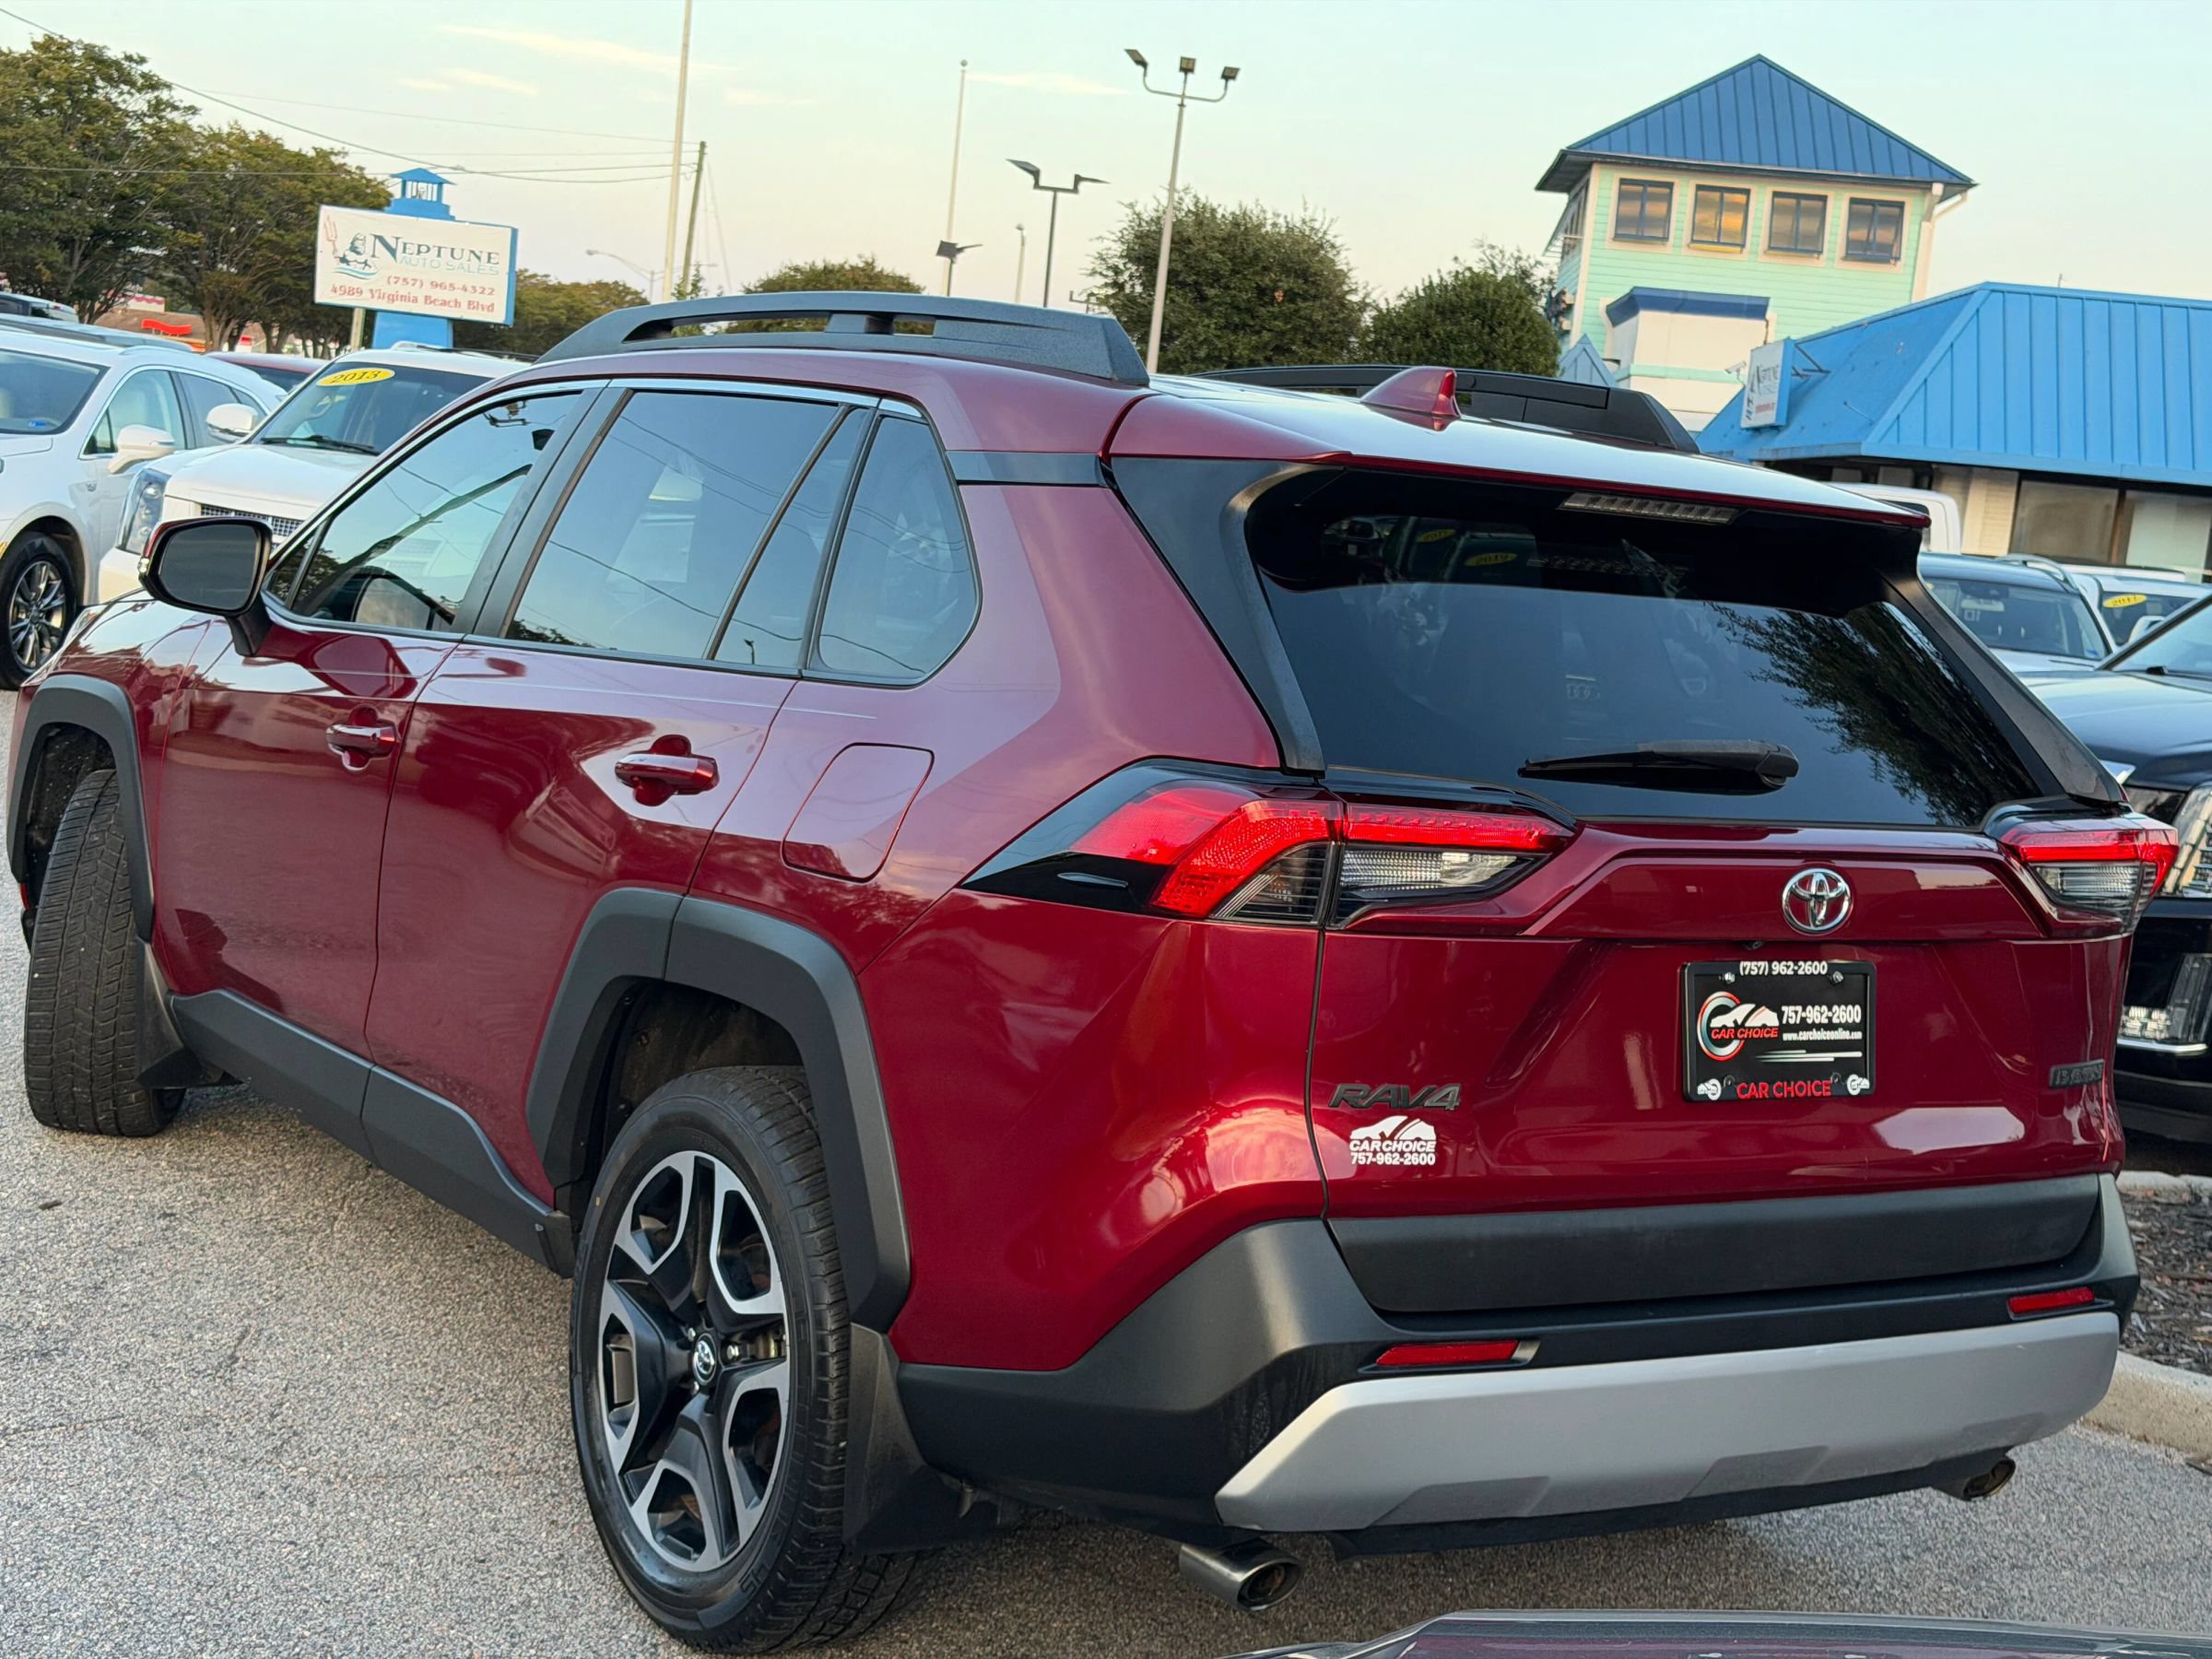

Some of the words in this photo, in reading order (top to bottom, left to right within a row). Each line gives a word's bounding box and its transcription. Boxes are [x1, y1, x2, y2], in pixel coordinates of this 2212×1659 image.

[369, 233, 500, 265] NEPTUNE
[400, 255, 441, 270] AUTO
[446, 260, 500, 276] SALES
[387, 275, 424, 289] (757)
[369, 288, 418, 304] Virginia
[424, 294, 462, 309] Beach
[466, 300, 495, 313] Blvd
[331, 371, 382, 383] 2013
[1739, 960, 1769, 976] (757)
[1711, 1028, 1735, 1040] CAR
[1736, 1027, 1779, 1039] CHOICE
[1782, 1027, 1863, 1041] www.carchoiceonline.com
[1329, 1082, 1462, 1111] RAV4
[1736, 1082, 1769, 1100] CAR
[1772, 1079, 1832, 1099] CHOICE
[1349, 1140, 1382, 1152] CAR
[1382, 1140, 1437, 1152] CHOICE
[1350, 1152, 1436, 1166] 757-962-2600
